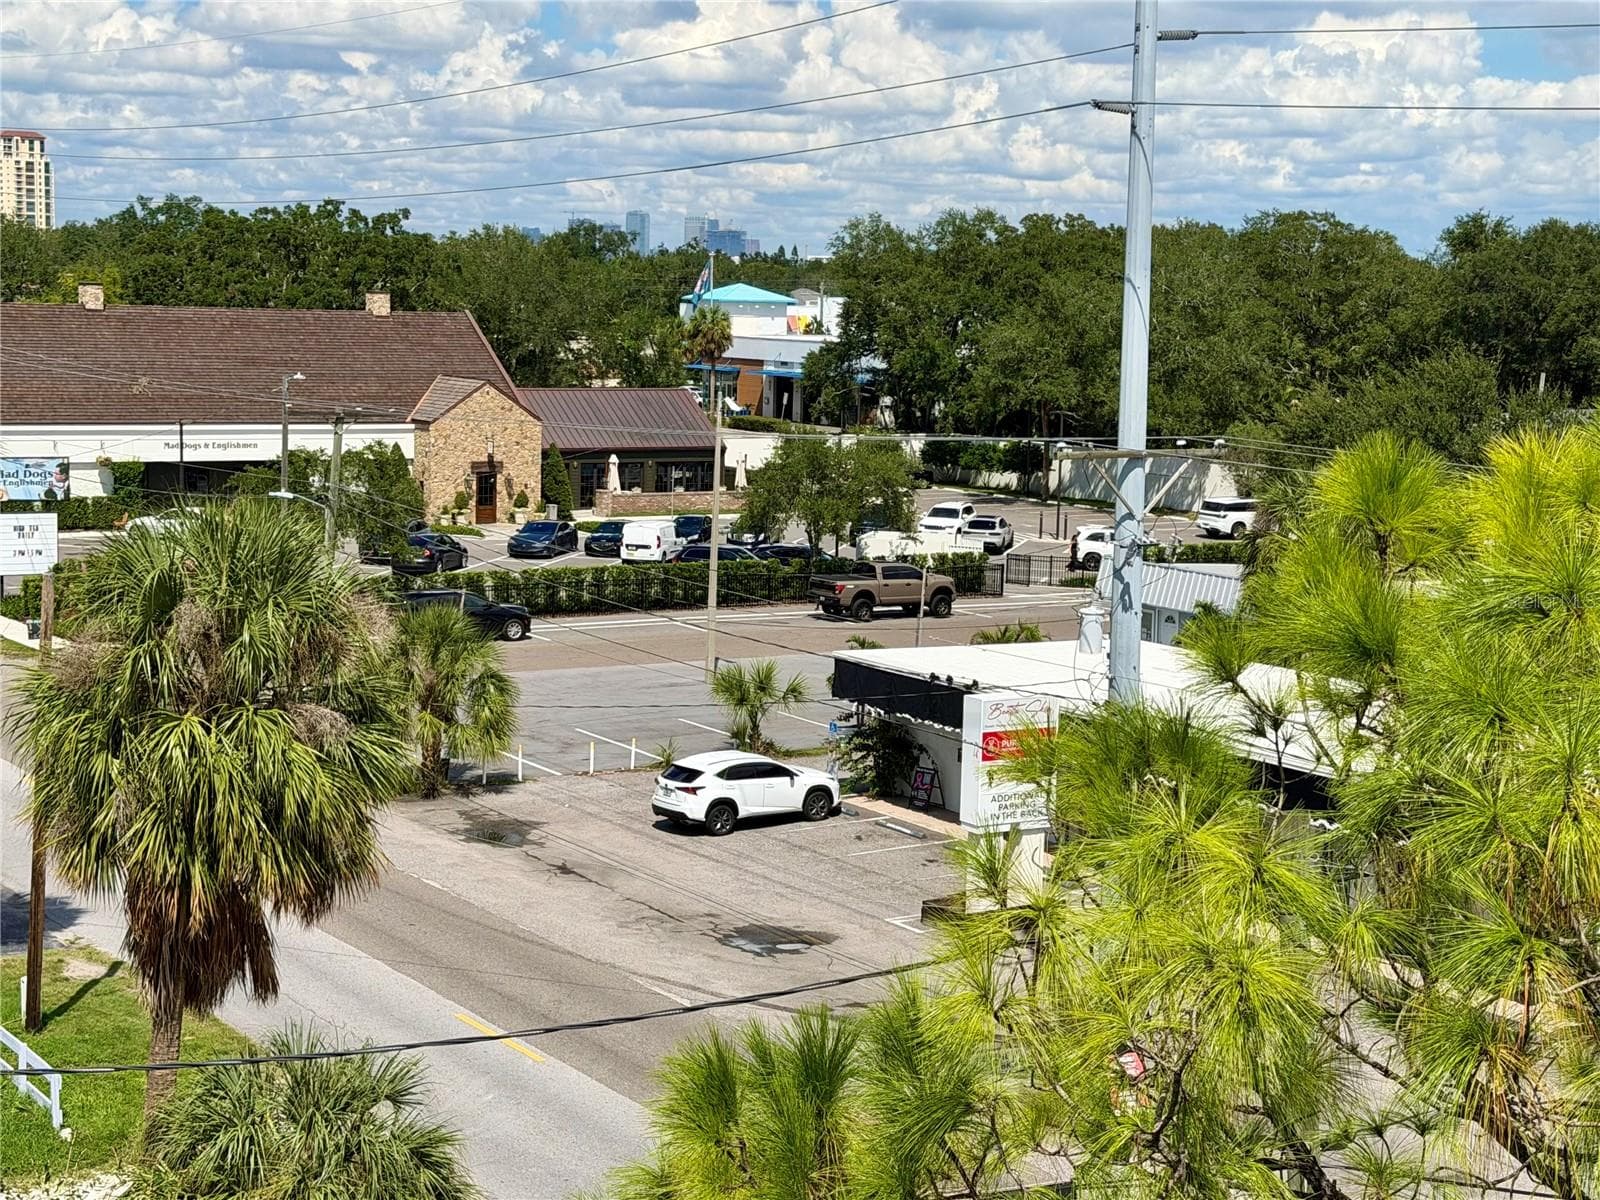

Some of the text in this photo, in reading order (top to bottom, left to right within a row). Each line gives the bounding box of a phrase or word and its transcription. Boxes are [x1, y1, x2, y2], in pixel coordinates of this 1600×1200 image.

[181, 442, 202, 451] Dogs
[212, 441, 258, 451] Englishmen
[23, 469, 54, 481] Dogs
[990, 792, 1045, 804] ADDITIONAL
[998, 800, 1036, 811] PARKING
[1001, 811, 1018, 820] THE
[1020, 809, 1043, 818] BACK
